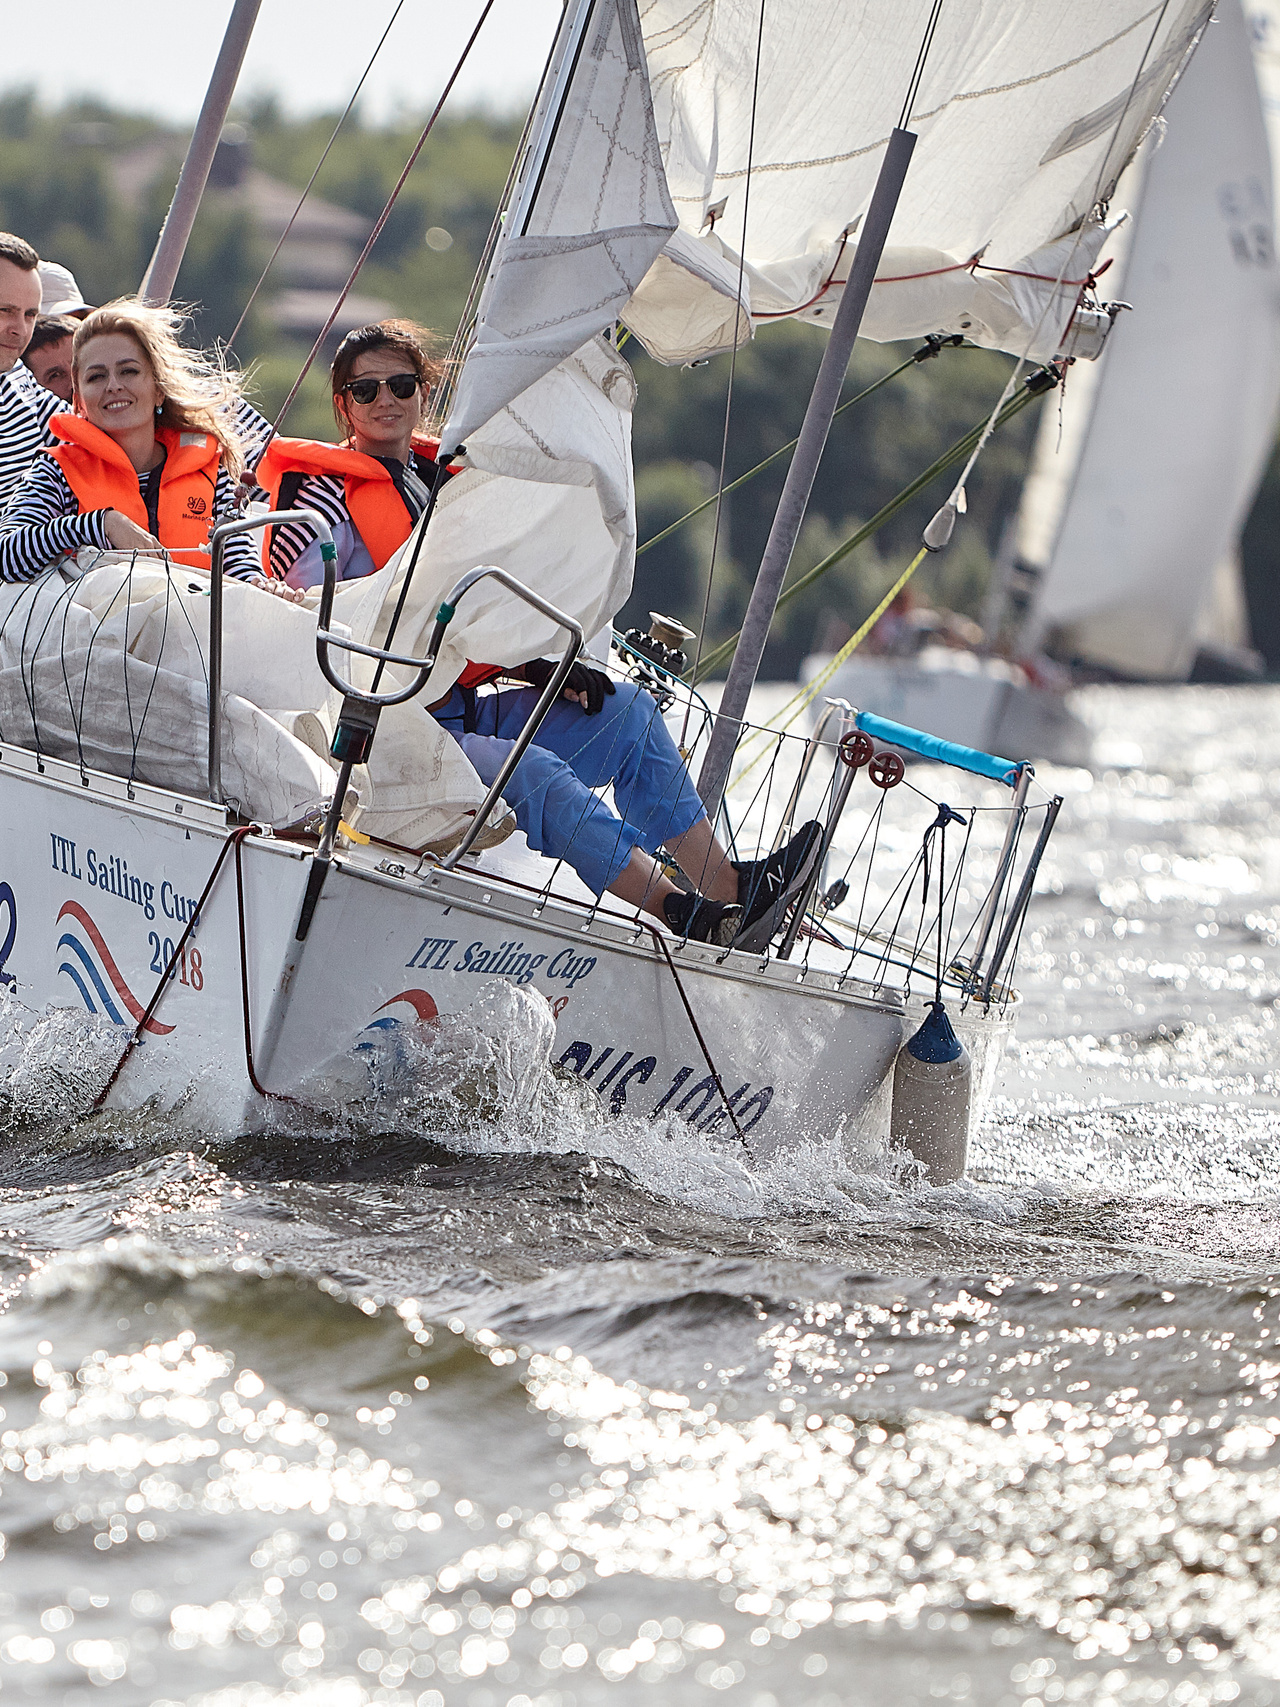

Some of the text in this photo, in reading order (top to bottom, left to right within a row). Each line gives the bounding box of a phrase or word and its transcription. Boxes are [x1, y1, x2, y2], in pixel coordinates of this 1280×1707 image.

[50, 832, 201, 939] ITL Sailing Cup
[148, 931, 204, 991] 2018
[405, 937, 598, 988] ITL Sailing Cup
